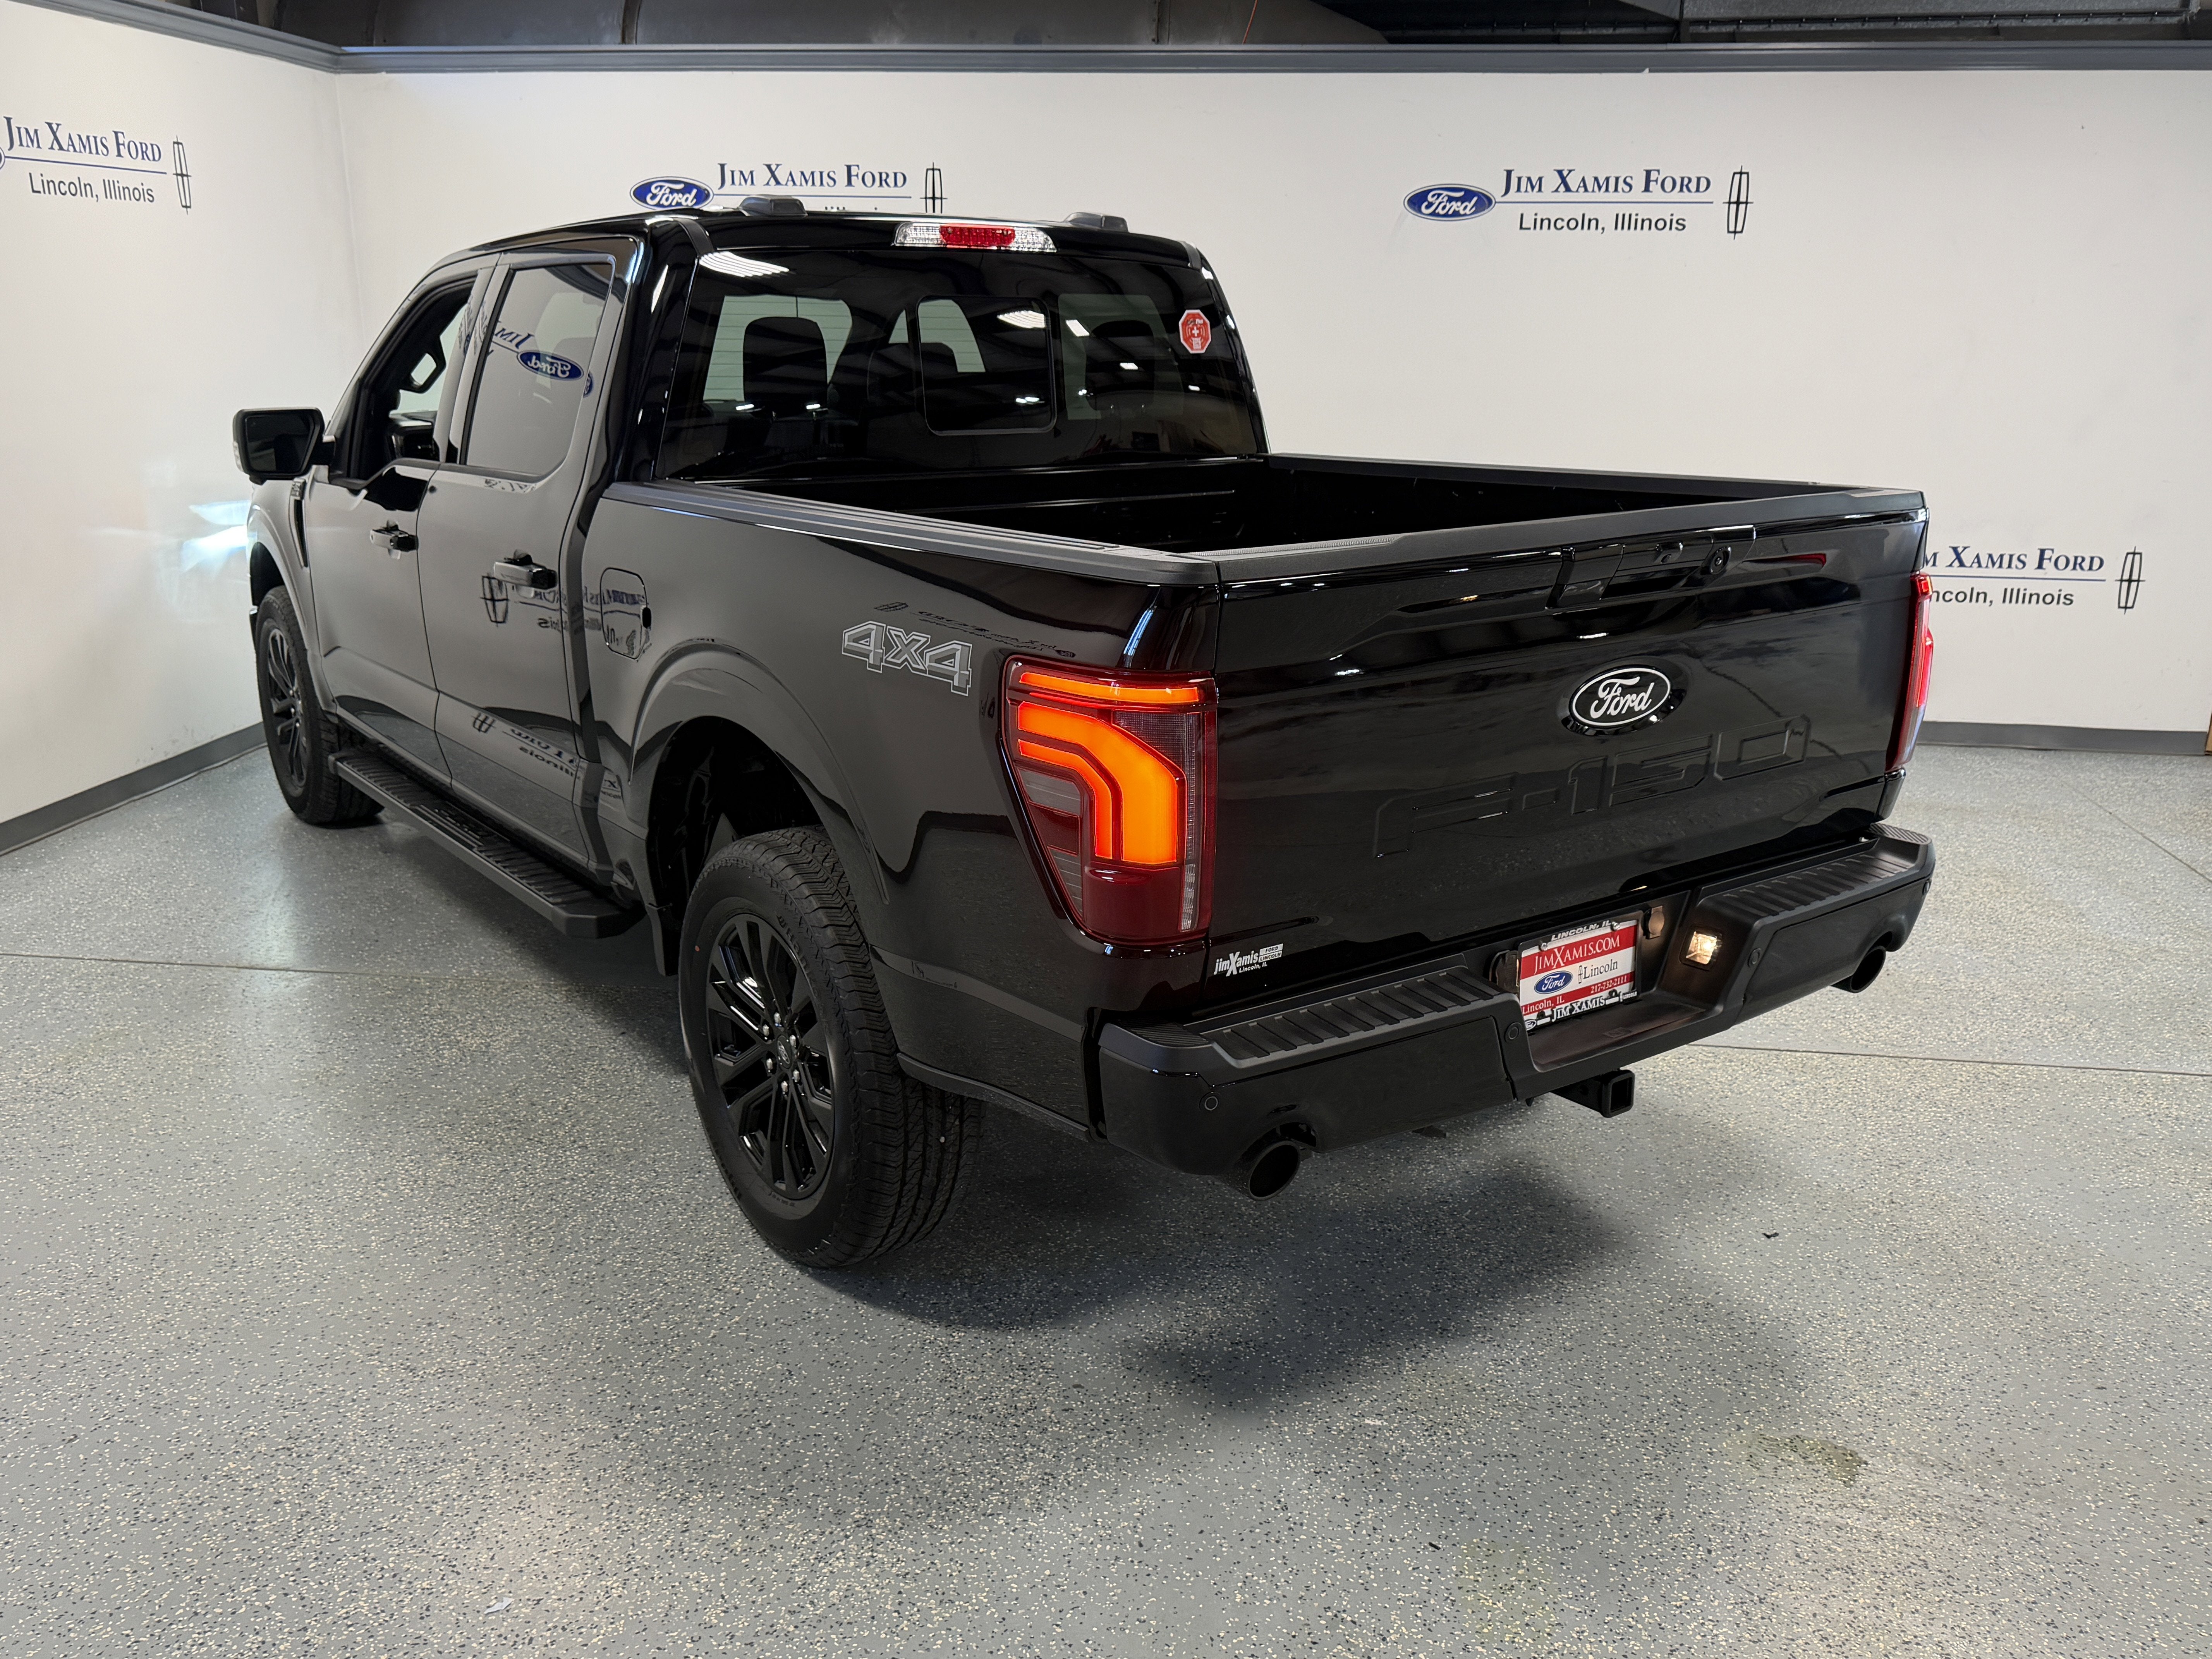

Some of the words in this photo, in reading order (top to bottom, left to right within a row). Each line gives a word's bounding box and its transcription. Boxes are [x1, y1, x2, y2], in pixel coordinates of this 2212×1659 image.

[3, 116, 42, 151] JIM
[45, 121, 109, 156] XAMIS
[112, 130, 161, 162] FORD
[29, 172, 98, 203] Lincoln,
[103, 179, 155, 203] Illinois
[718, 163, 756, 190] JIM
[763, 163, 836, 187] XAMIS
[845, 164, 907, 188] FORD
[1501, 169, 1544, 198] JIM
[1551, 169, 1633, 193] XAMIS
[1642, 169, 1711, 193] FORD
[646, 182, 697, 206] Ford
[1421, 190, 1478, 215] Ford
[1519, 213, 1605, 234] Lincoln,
[1614, 213, 1686, 232] Illinois
[1945, 546, 2027, 570] XAMIS
[2034, 548, 2104, 572] FORD
[1931, 587, 1993, 607] ncoln,
[2002, 587, 2074, 606] Illinois
[1590, 676, 1655, 719] Ford
[1373, 714, 1811, 858] F-150
[1583, 958, 1618, 980] Lincoln
[1542, 974, 1565, 991] Ford
[1551, 1006, 1570, 1022] JIM
[1571, 996, 1606, 1015] XAMIS
[1556, 996, 1565, 1004] IL
